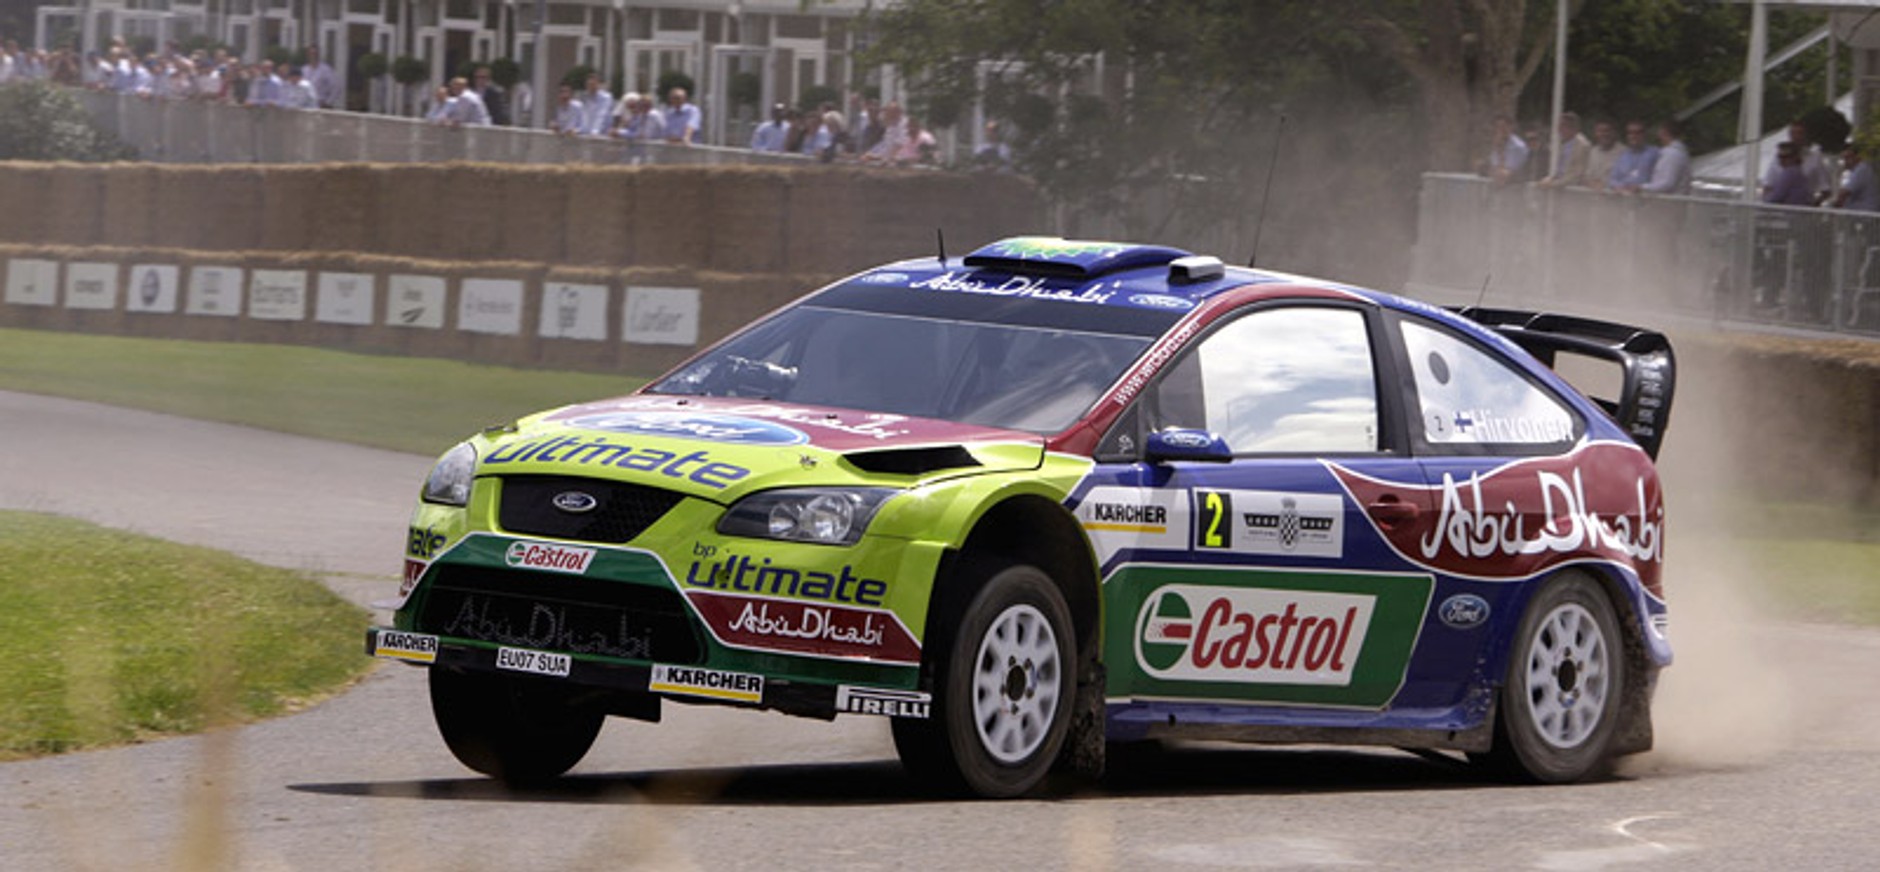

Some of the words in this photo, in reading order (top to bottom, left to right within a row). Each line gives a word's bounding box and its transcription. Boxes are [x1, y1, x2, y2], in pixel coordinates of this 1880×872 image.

[909, 271, 990, 293] Abu
[996, 276, 1119, 304] Dhabi
[1472, 409, 1574, 442] Hirvonen
[484, 436, 751, 489] ultimate
[1204, 492, 1223, 547] 2
[1421, 470, 1528, 559] Abu
[1530, 466, 1662, 563] Dhabi
[524, 545, 590, 571] Castrol
[693, 541, 718, 559] bp
[687, 555, 888, 607] ultimate
[443, 597, 514, 642] Abu
[525, 602, 652, 658] Dhabi
[729, 602, 793, 636] Abu
[799, 607, 885, 646] Dhabi
[1444, 598, 1485, 625] Ford
[1191, 597, 1358, 672] Castrol
[500, 650, 535, 668] EU07
[537, 655, 568, 674] SUA
[836, 684, 932, 718] PIRELLI
